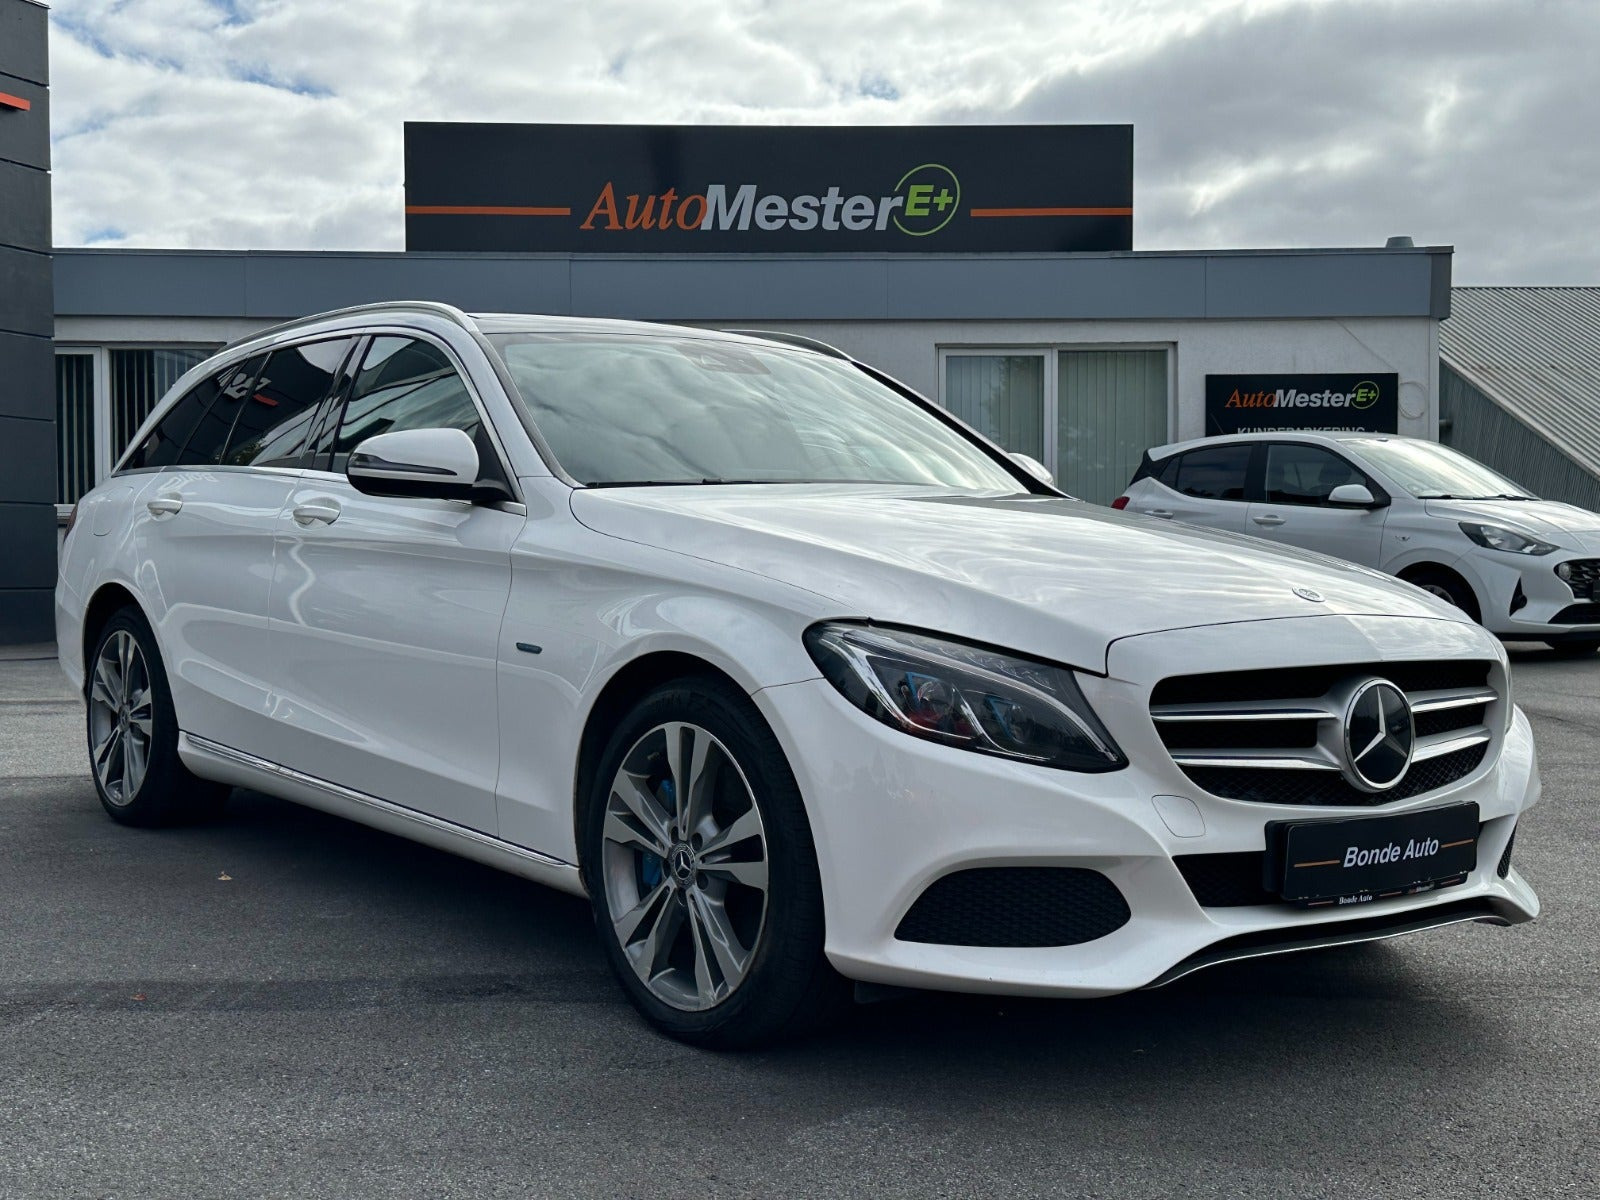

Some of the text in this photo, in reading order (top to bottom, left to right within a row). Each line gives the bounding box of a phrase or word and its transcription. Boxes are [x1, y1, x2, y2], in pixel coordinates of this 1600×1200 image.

[580, 181, 903, 231] AutoMester
[1225, 388, 1356, 408] AutoMester
[1343, 838, 1439, 868] Bonde Auto
